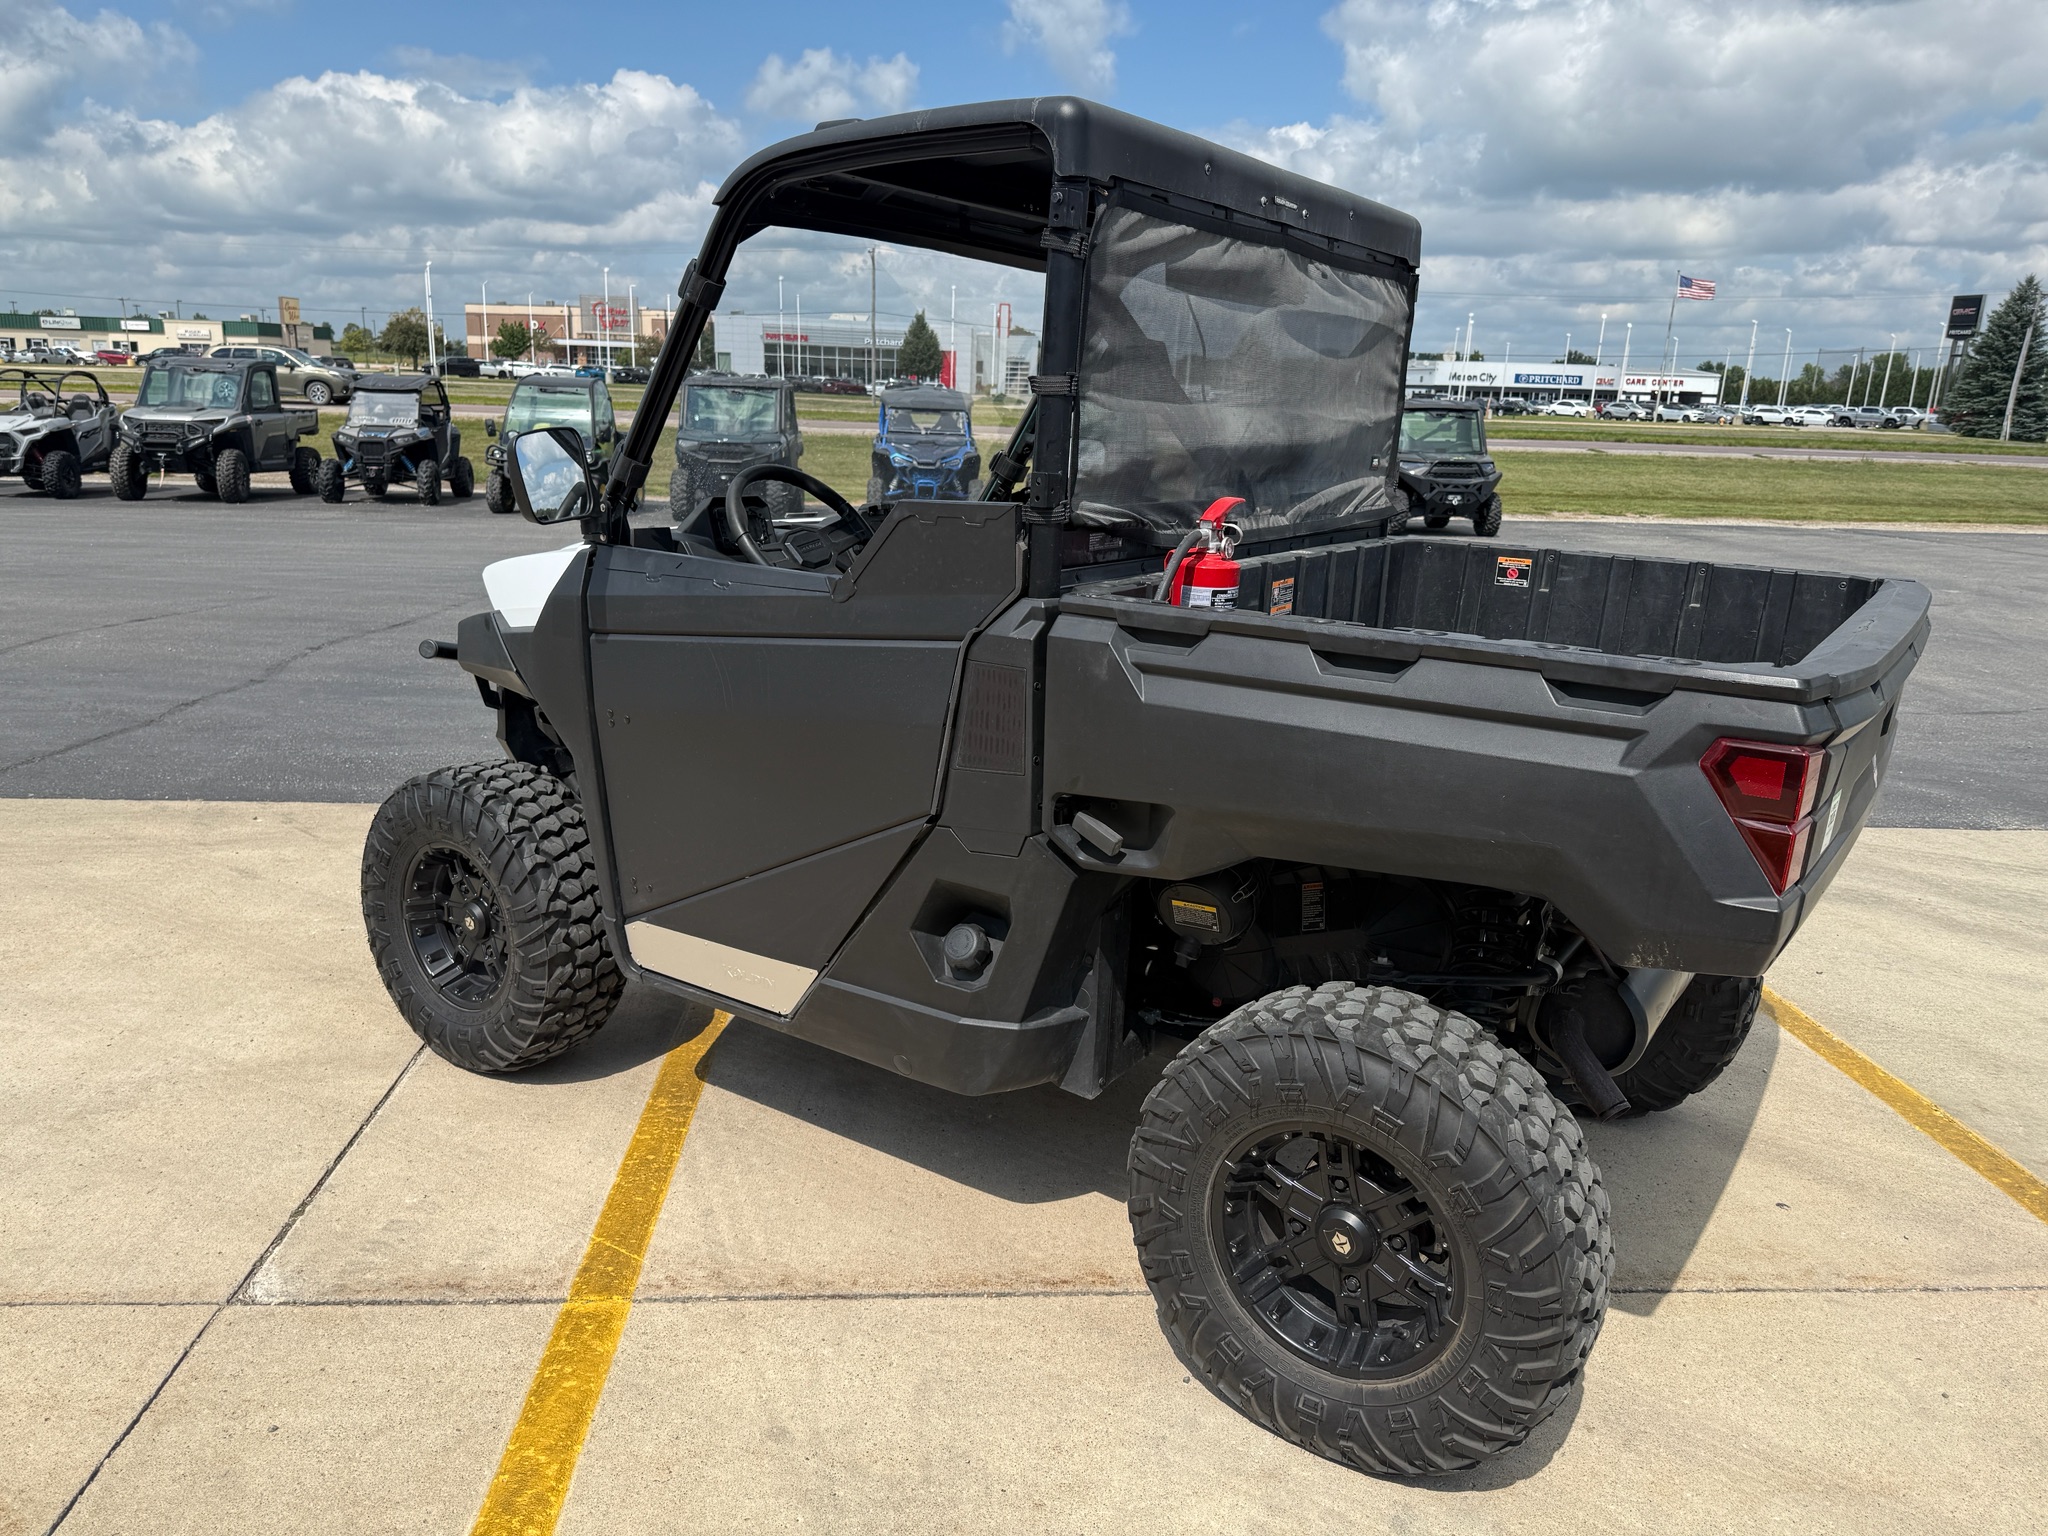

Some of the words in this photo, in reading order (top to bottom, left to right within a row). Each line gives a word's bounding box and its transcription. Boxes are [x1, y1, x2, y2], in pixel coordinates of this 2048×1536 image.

[1952, 308, 1977, 316] GMC
[864, 337, 904, 347] Prtchard
[1479, 372, 1497, 385] City
[1529, 375, 1580, 385] PRITCHARD
[1625, 378, 1647, 386] CARE
